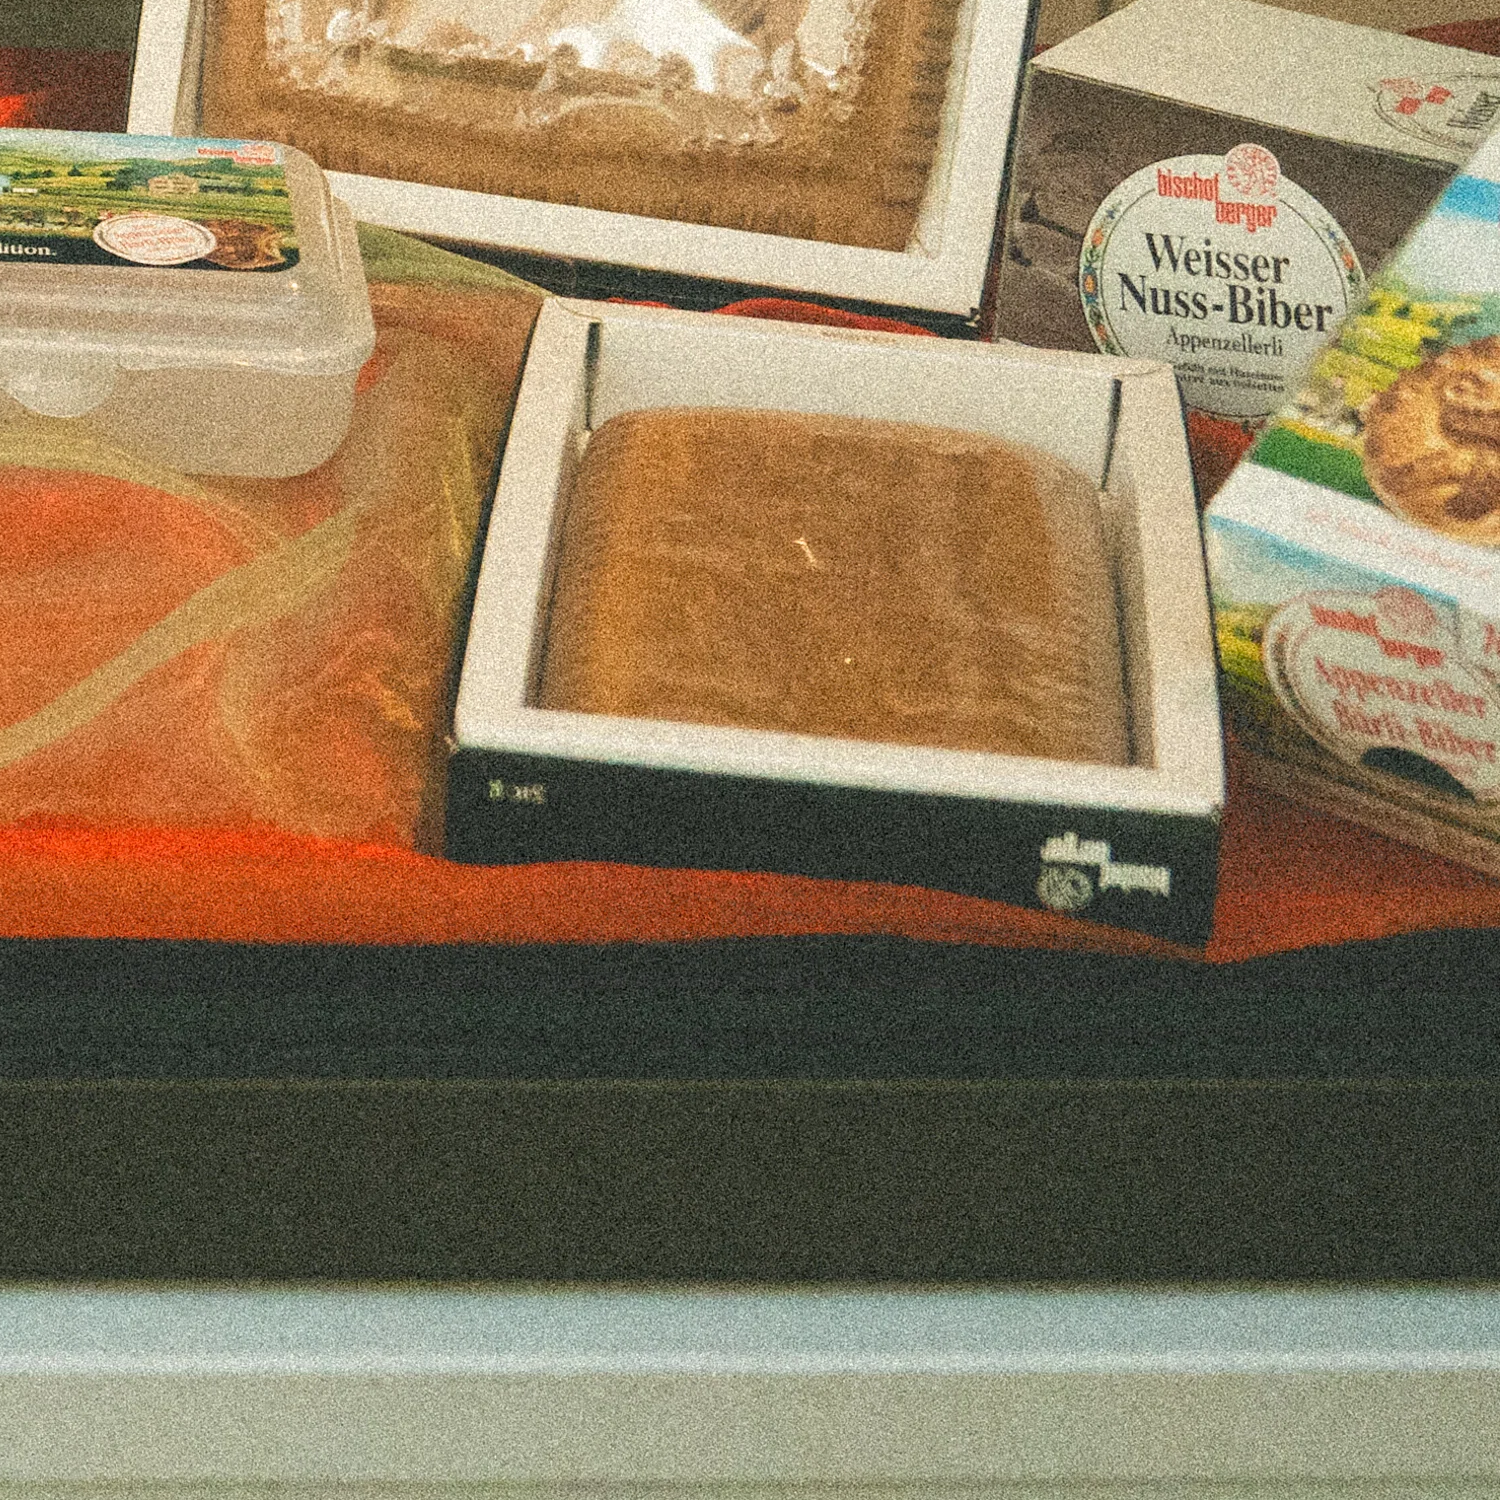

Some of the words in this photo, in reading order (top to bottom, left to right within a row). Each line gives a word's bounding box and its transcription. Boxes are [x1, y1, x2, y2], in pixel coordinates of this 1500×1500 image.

[1156, 168, 1219, 202] bischof
[1215, 200, 1278, 234] berger
[1144, 232, 1290, 284] Weisser
[1117, 272, 1334, 332] Nuss-Biber
[1165, 326, 1284, 357] Appenzellerli
